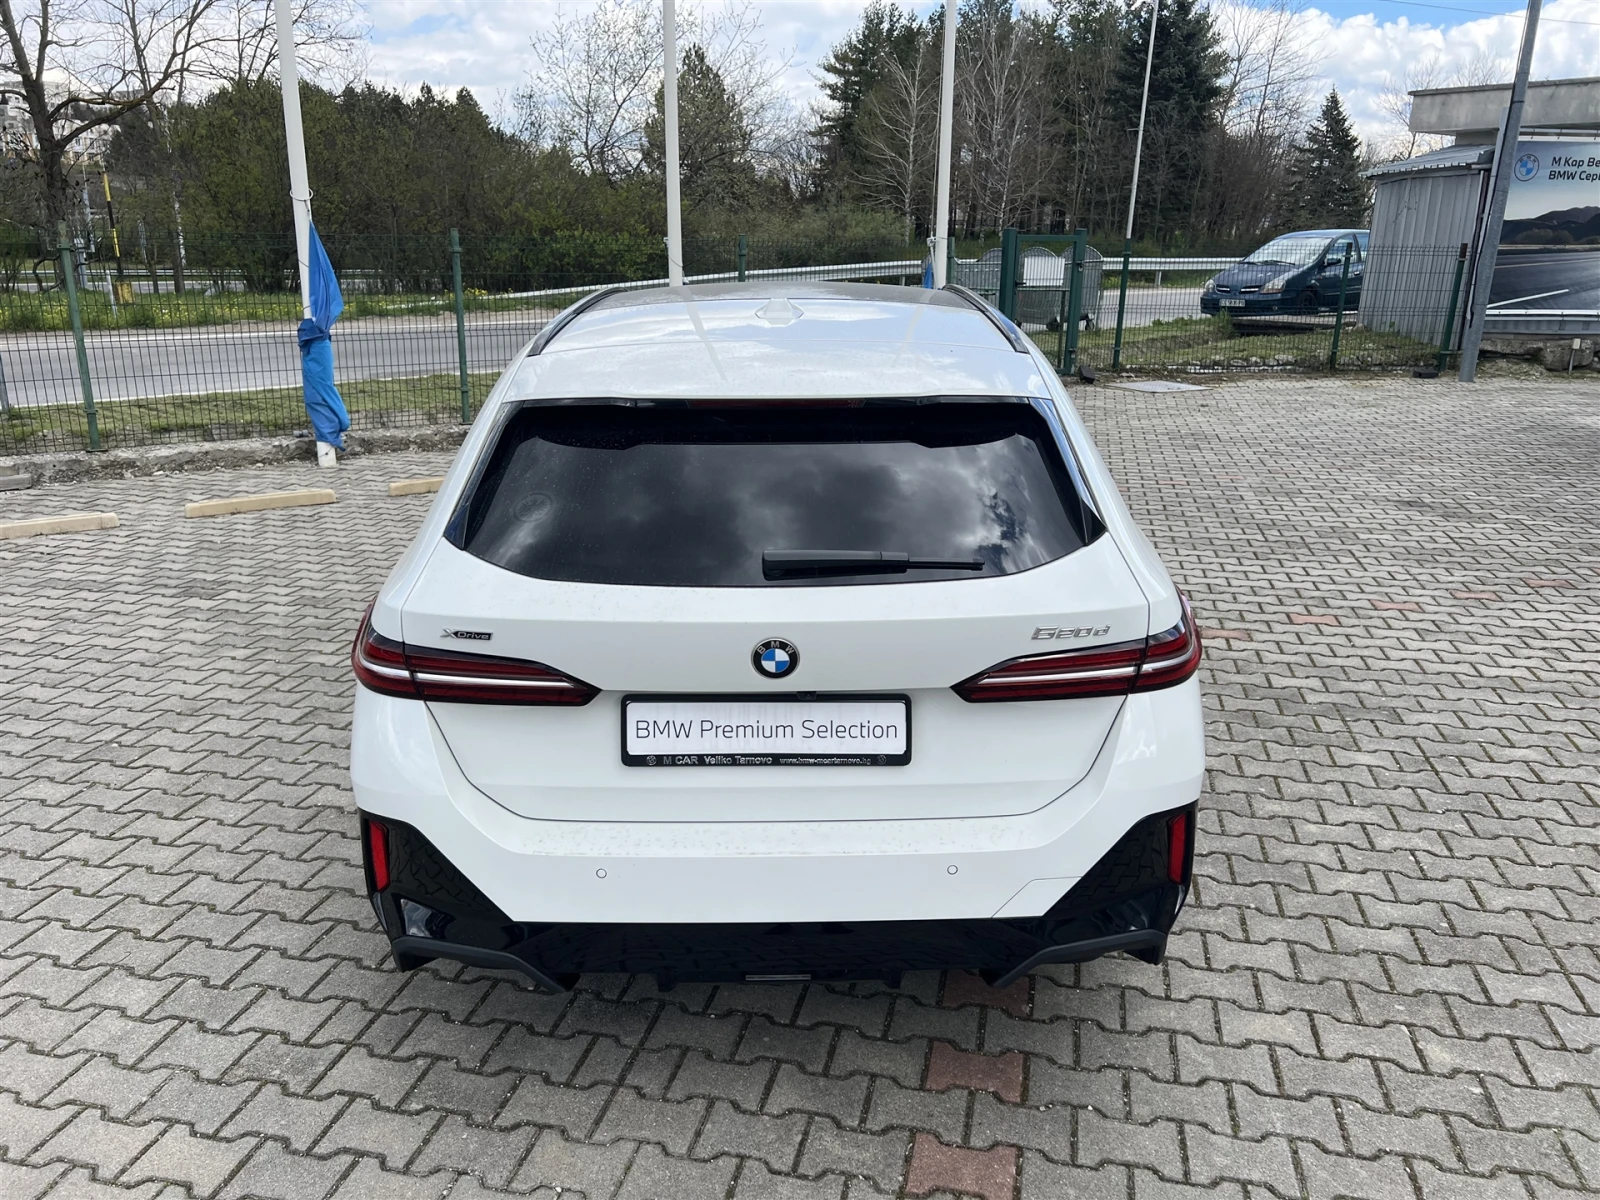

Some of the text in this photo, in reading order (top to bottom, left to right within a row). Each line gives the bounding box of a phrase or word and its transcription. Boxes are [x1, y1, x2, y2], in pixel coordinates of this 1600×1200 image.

[1548, 170, 1578, 180] BMW
[1031, 624, 1112, 640] 520d
[635, 719, 898, 739] BMW Premium Selection
[663, 756, 672, 765] M
[675, 756, 699, 765] CAR
[704, 755, 733, 765] Veliko
[735, 755, 773, 765] Tarnovo
